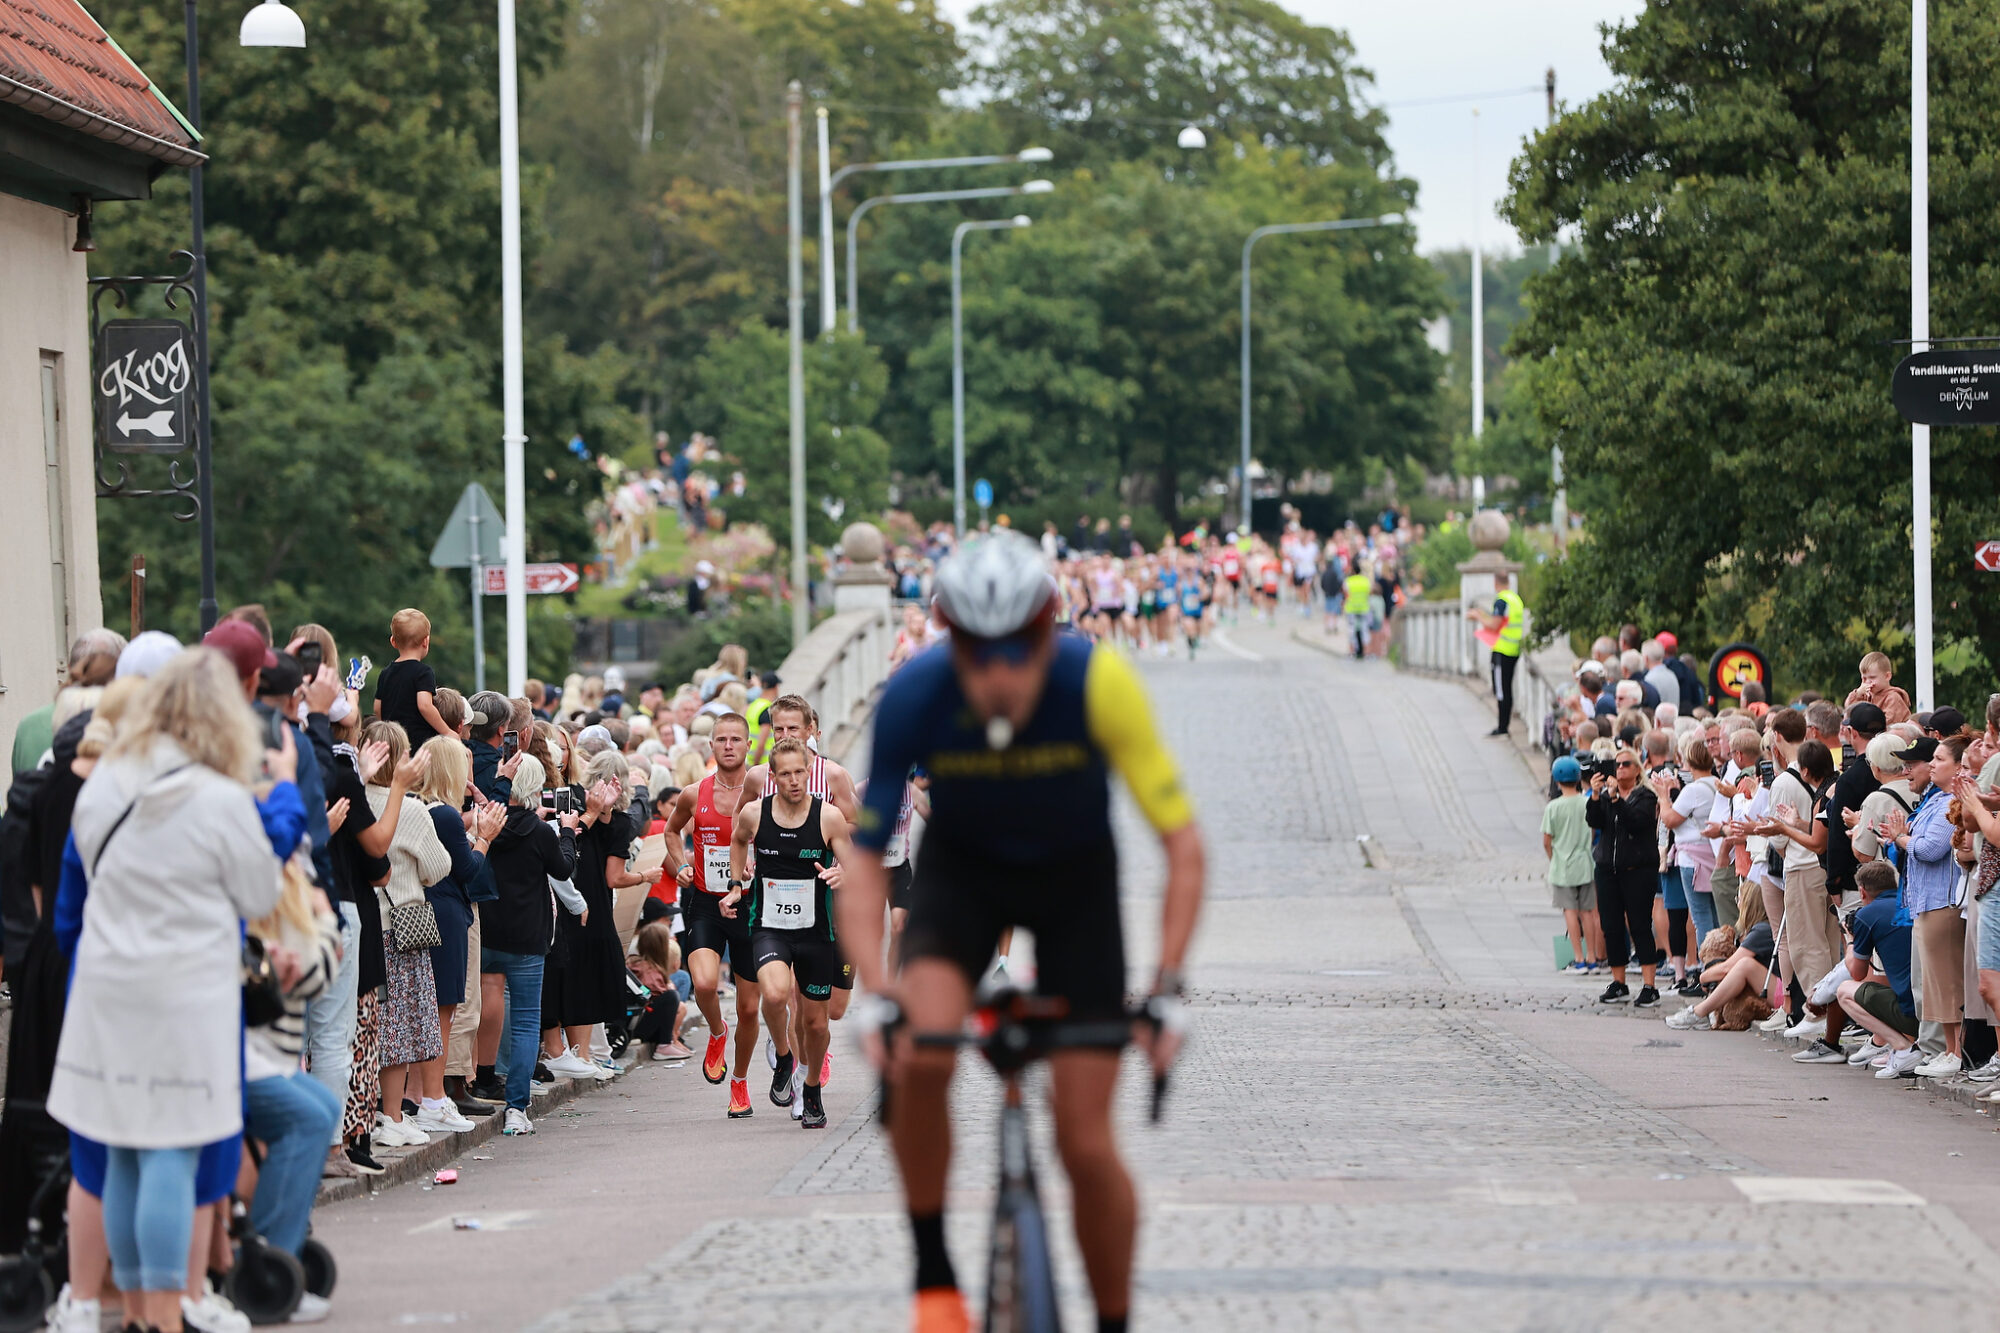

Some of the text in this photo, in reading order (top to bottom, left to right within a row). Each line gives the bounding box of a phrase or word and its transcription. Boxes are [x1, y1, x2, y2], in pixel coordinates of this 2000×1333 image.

[100, 338, 190, 409] Krog
[1910, 364, 1970, 376] Tandläkarna
[1950, 376, 1959, 384] en
[1960, 375, 1969, 384] del
[1940, 391, 1988, 402] DENTALUM
[799, 849, 822, 858] MAI
[775, 903, 802, 915] 759
